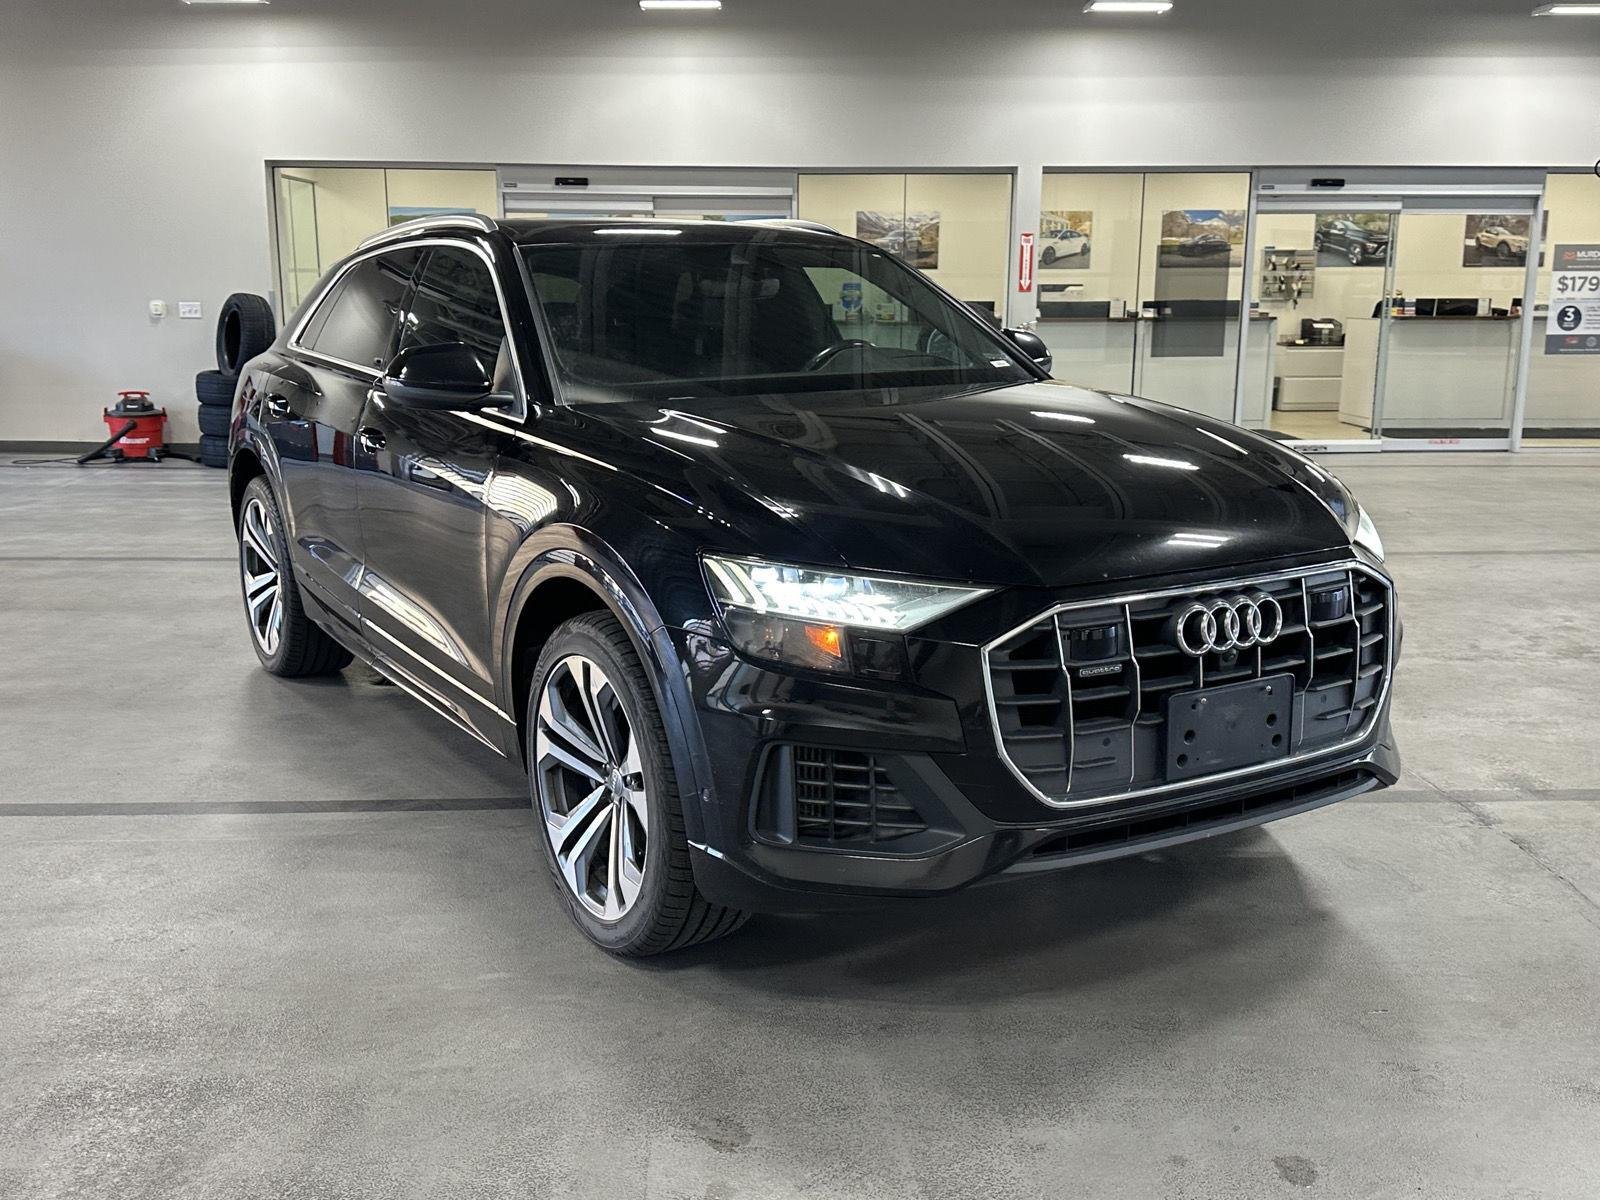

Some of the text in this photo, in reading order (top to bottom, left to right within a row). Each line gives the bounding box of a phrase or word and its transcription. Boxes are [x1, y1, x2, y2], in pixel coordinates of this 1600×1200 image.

[1557, 275, 1600, 293] $179
[1564, 307, 1575, 321] 3
[1081, 665, 1120, 677] quattro
